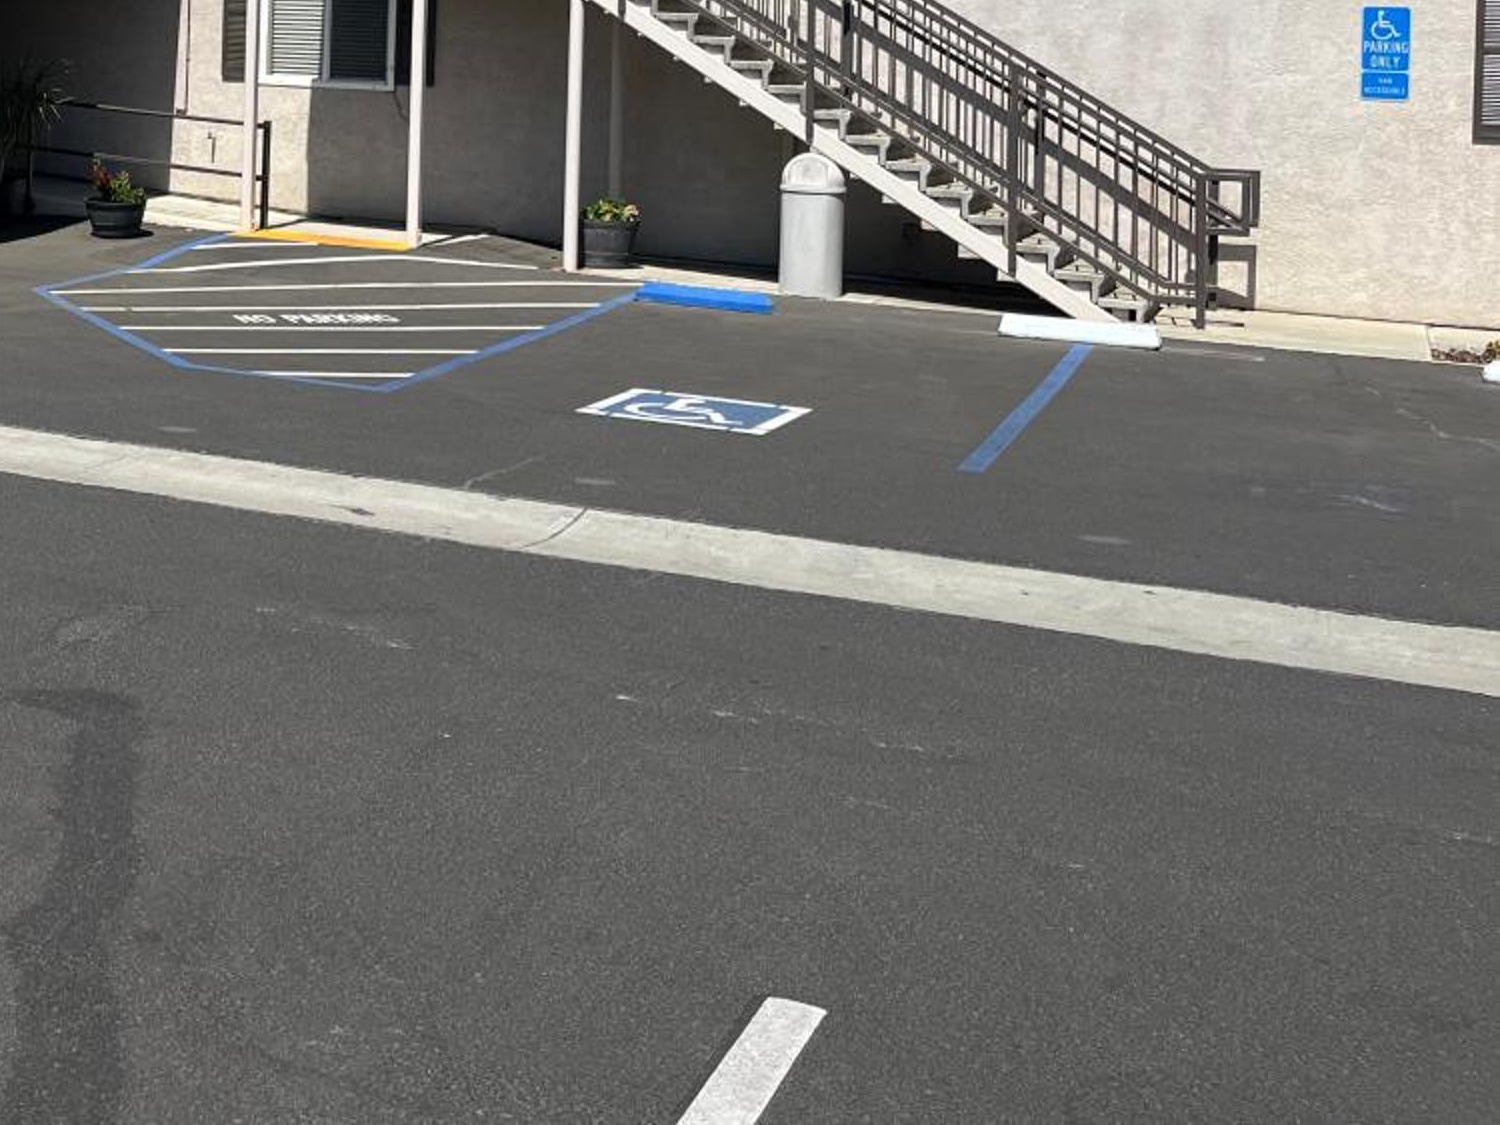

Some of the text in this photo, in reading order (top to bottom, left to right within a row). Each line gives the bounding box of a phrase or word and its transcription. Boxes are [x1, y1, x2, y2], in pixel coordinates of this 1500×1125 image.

[1363, 40, 1409, 54] PARKING
[1371, 55, 1400, 69] ONLY
[232, 312, 401, 324] NO PARKING
